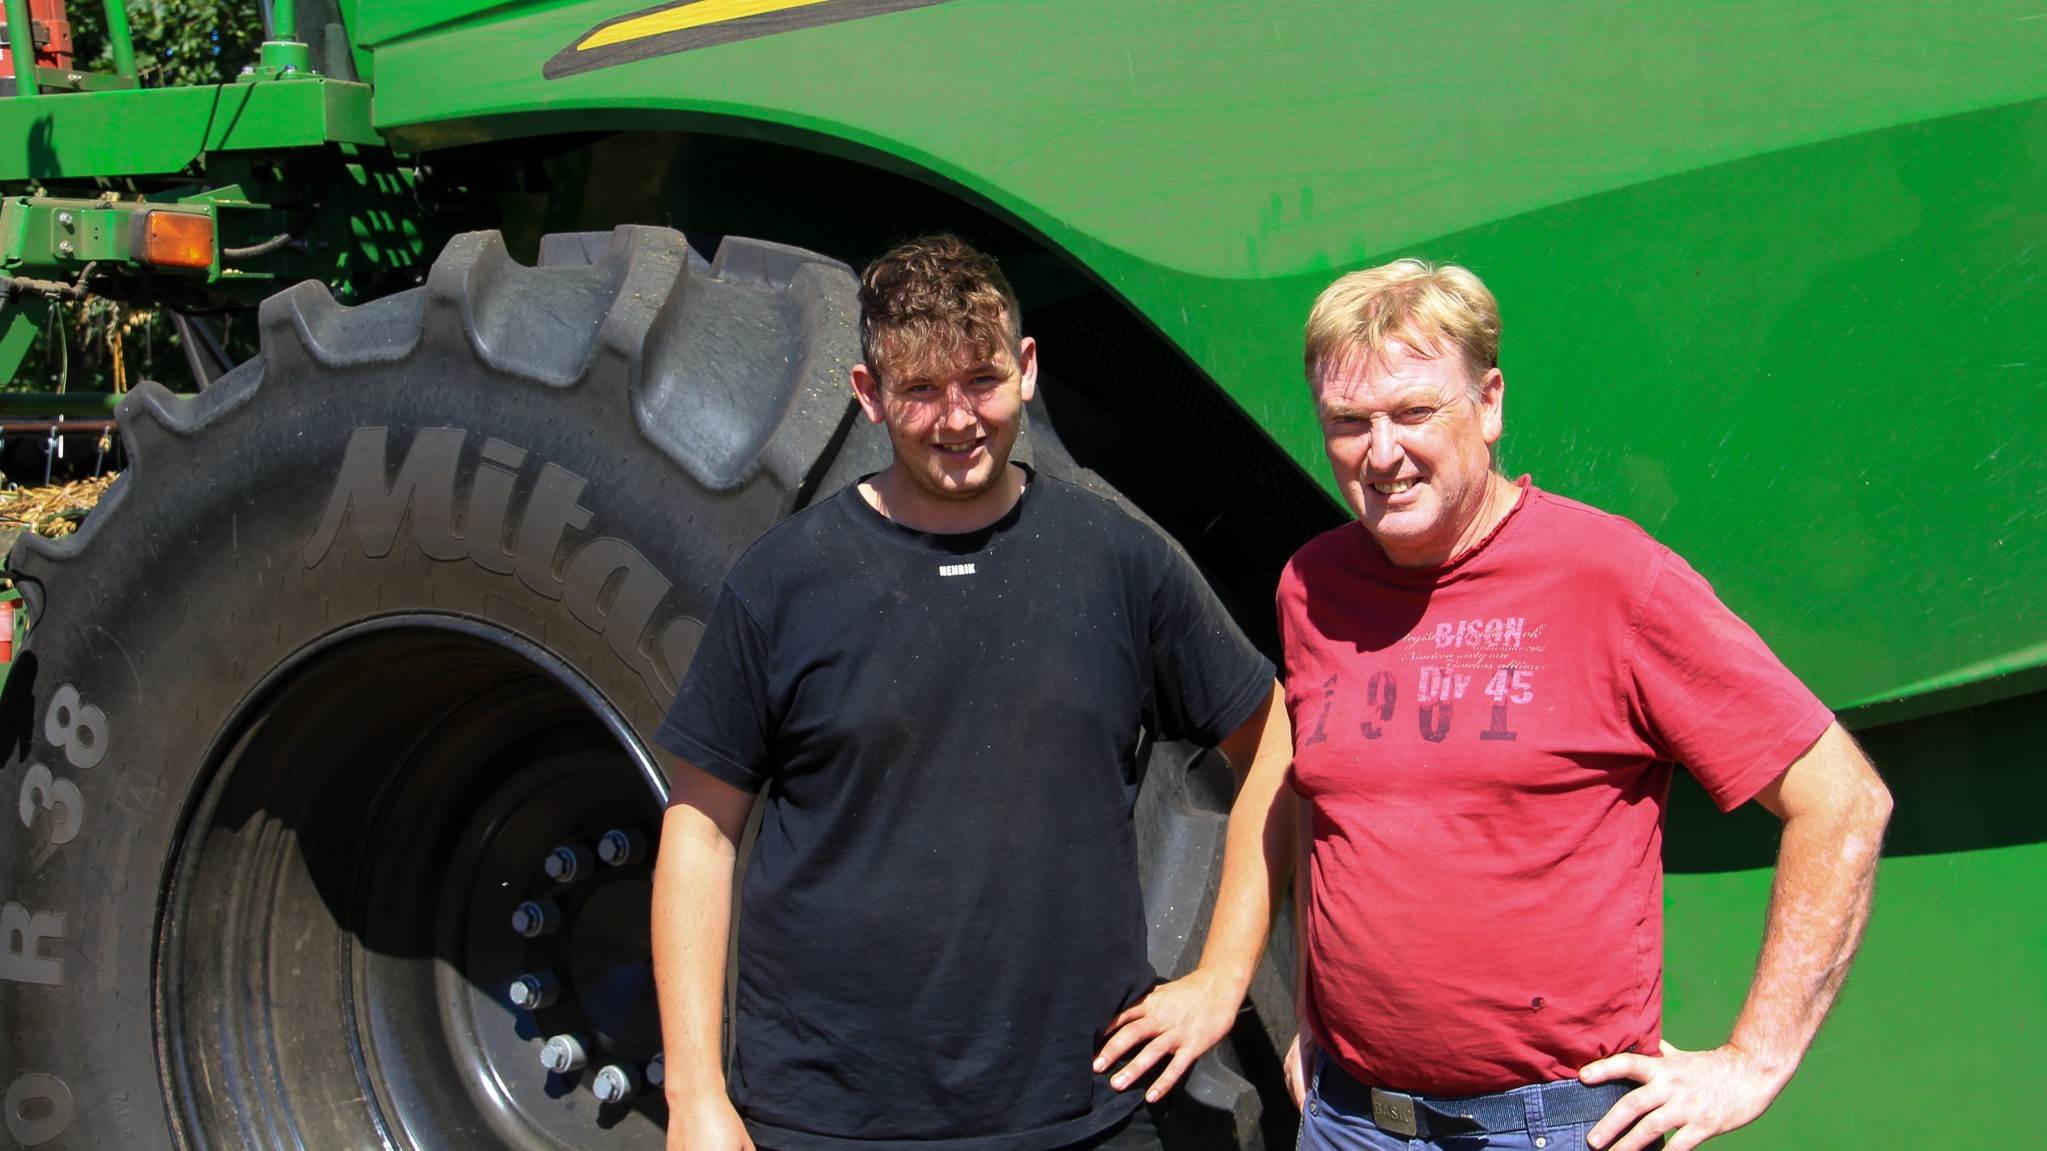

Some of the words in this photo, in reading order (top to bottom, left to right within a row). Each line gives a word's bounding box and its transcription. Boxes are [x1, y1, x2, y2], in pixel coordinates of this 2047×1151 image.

[939, 563, 976, 577] HENRIK
[1435, 617, 1524, 649] BISON
[1418, 665, 1472, 702] Div
[1484, 669, 1534, 705] 45
[19, 683, 110, 844] 38
[0, 901, 67, 986] R
[1374, 1101, 1413, 1122] BASIC
